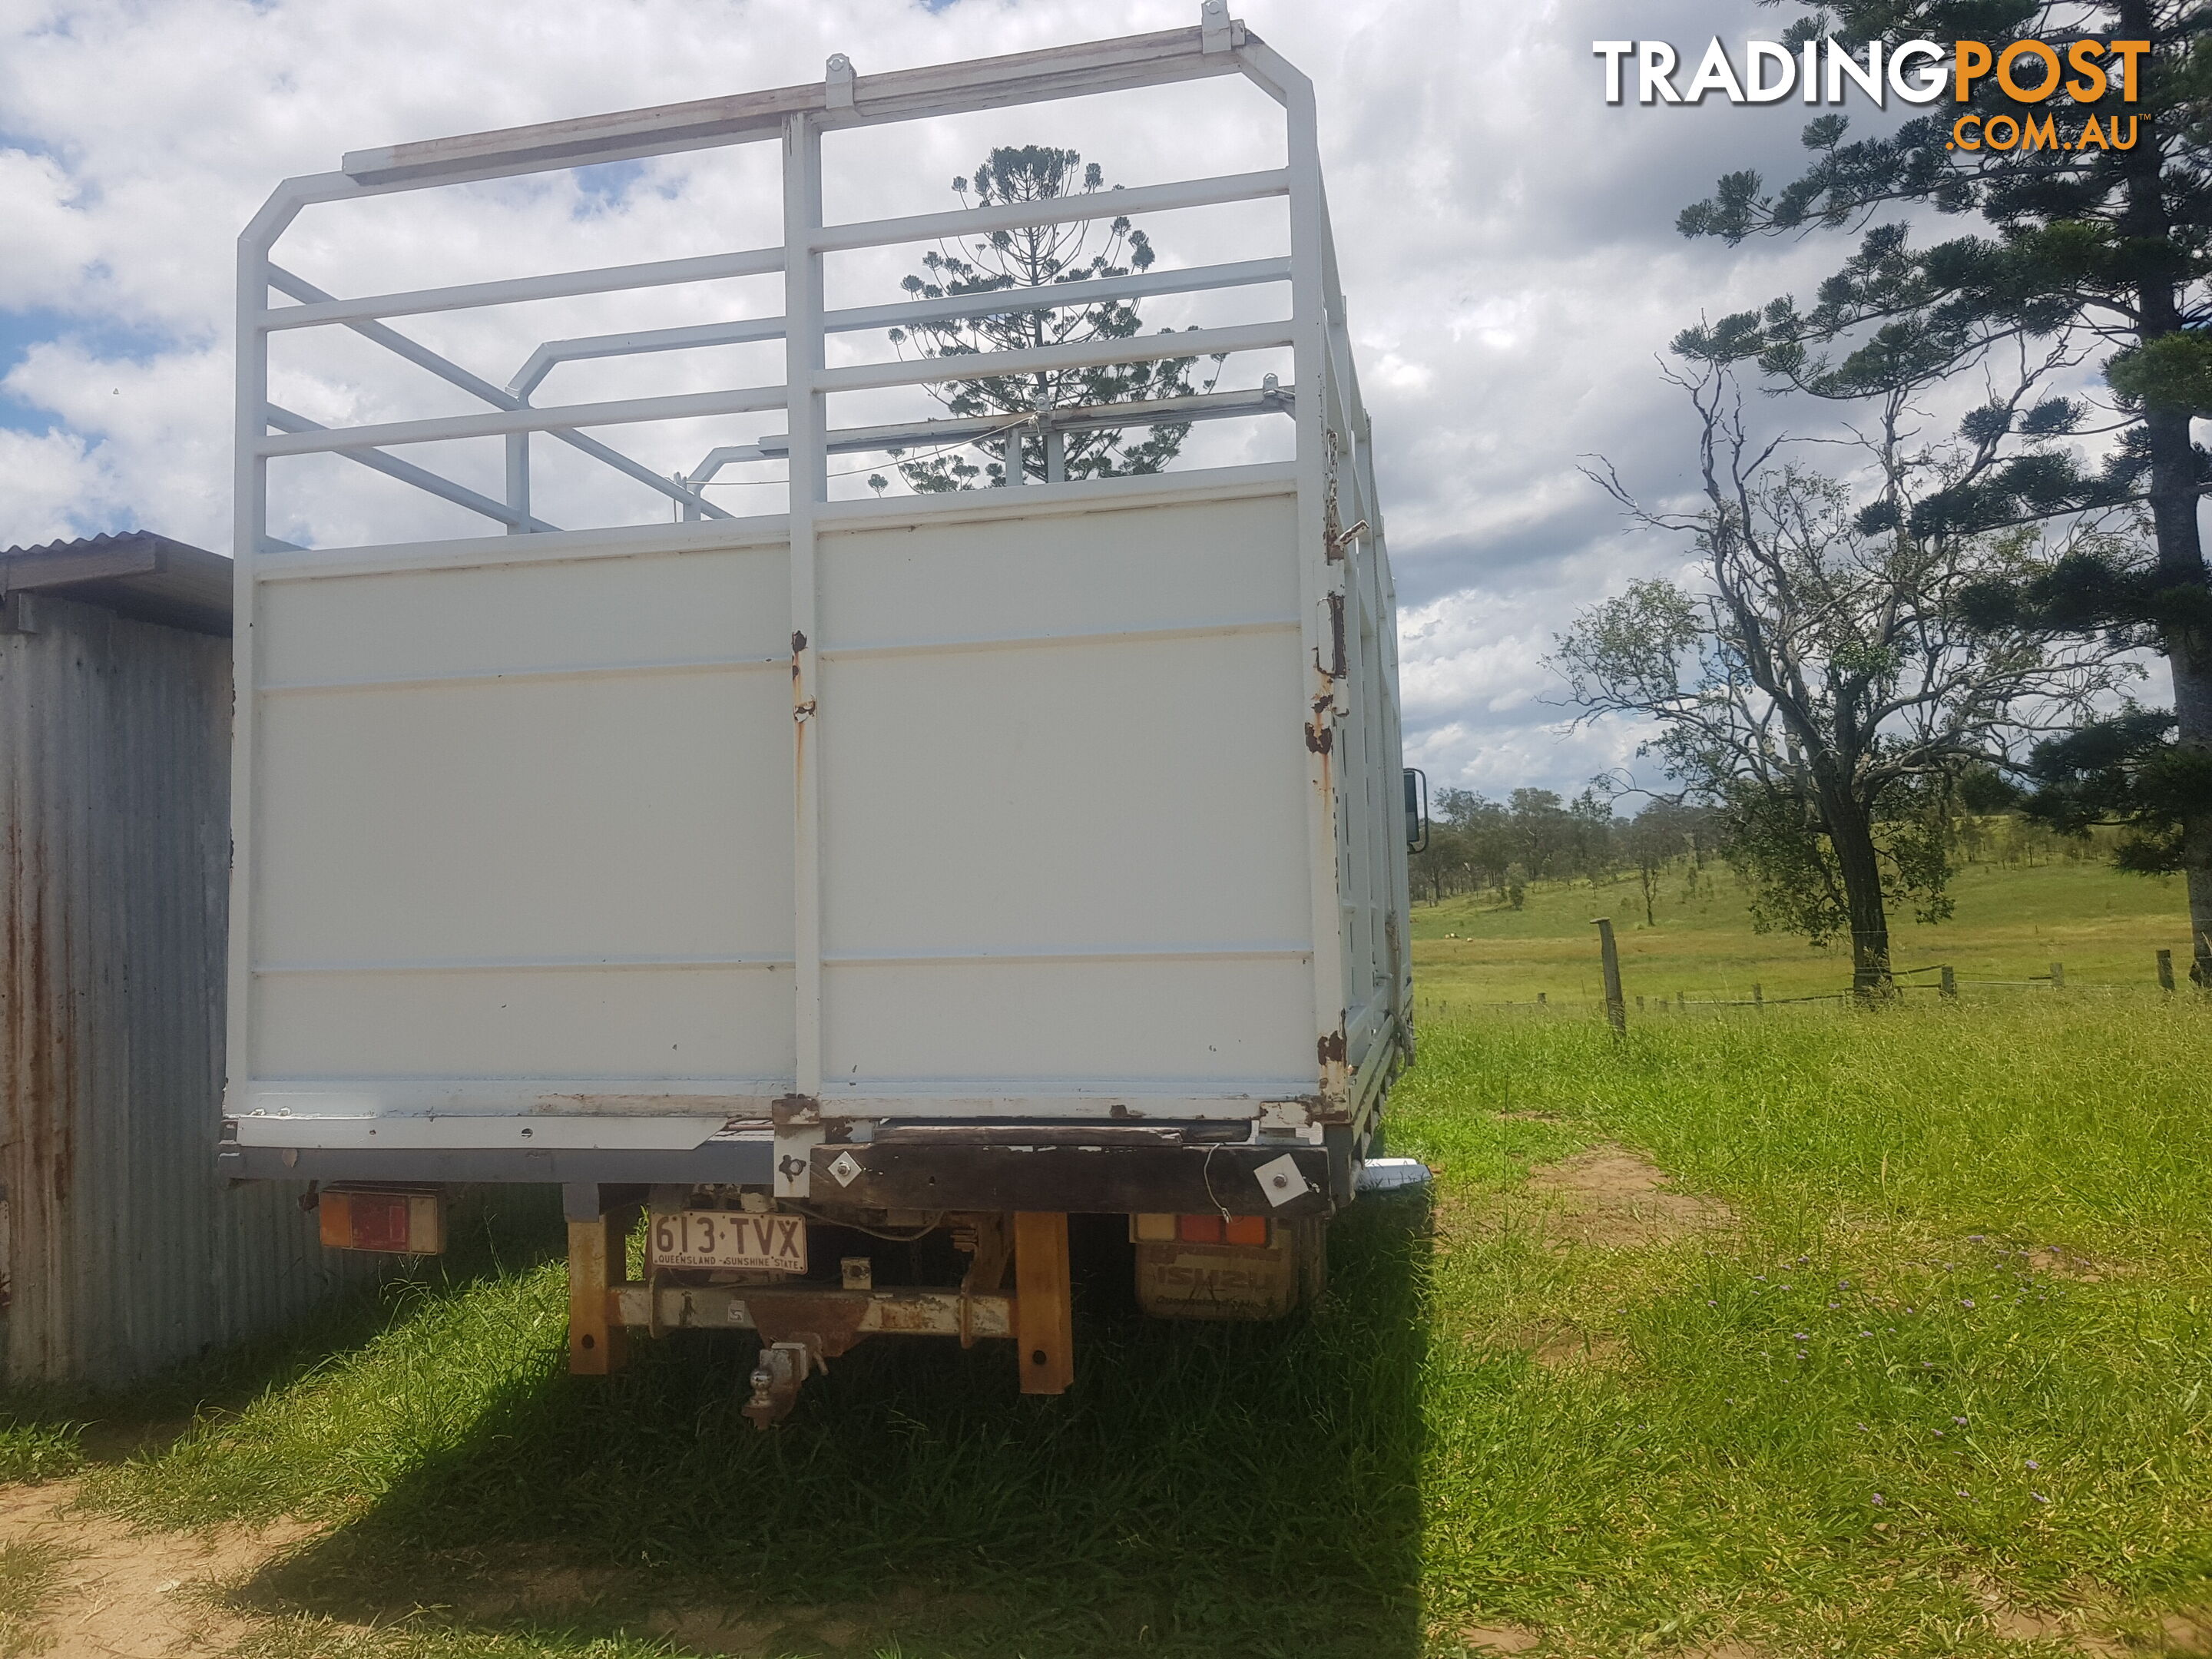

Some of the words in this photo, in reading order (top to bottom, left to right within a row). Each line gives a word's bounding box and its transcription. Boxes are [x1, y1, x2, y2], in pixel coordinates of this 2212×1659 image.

[656, 1216, 715, 1253] 613
[730, 1217, 800, 1258] TVX
[658, 1254, 716, 1265] QUEENSLAND
[725, 1257, 770, 1267] SUNSHINE
[774, 1258, 799, 1270] STATE
